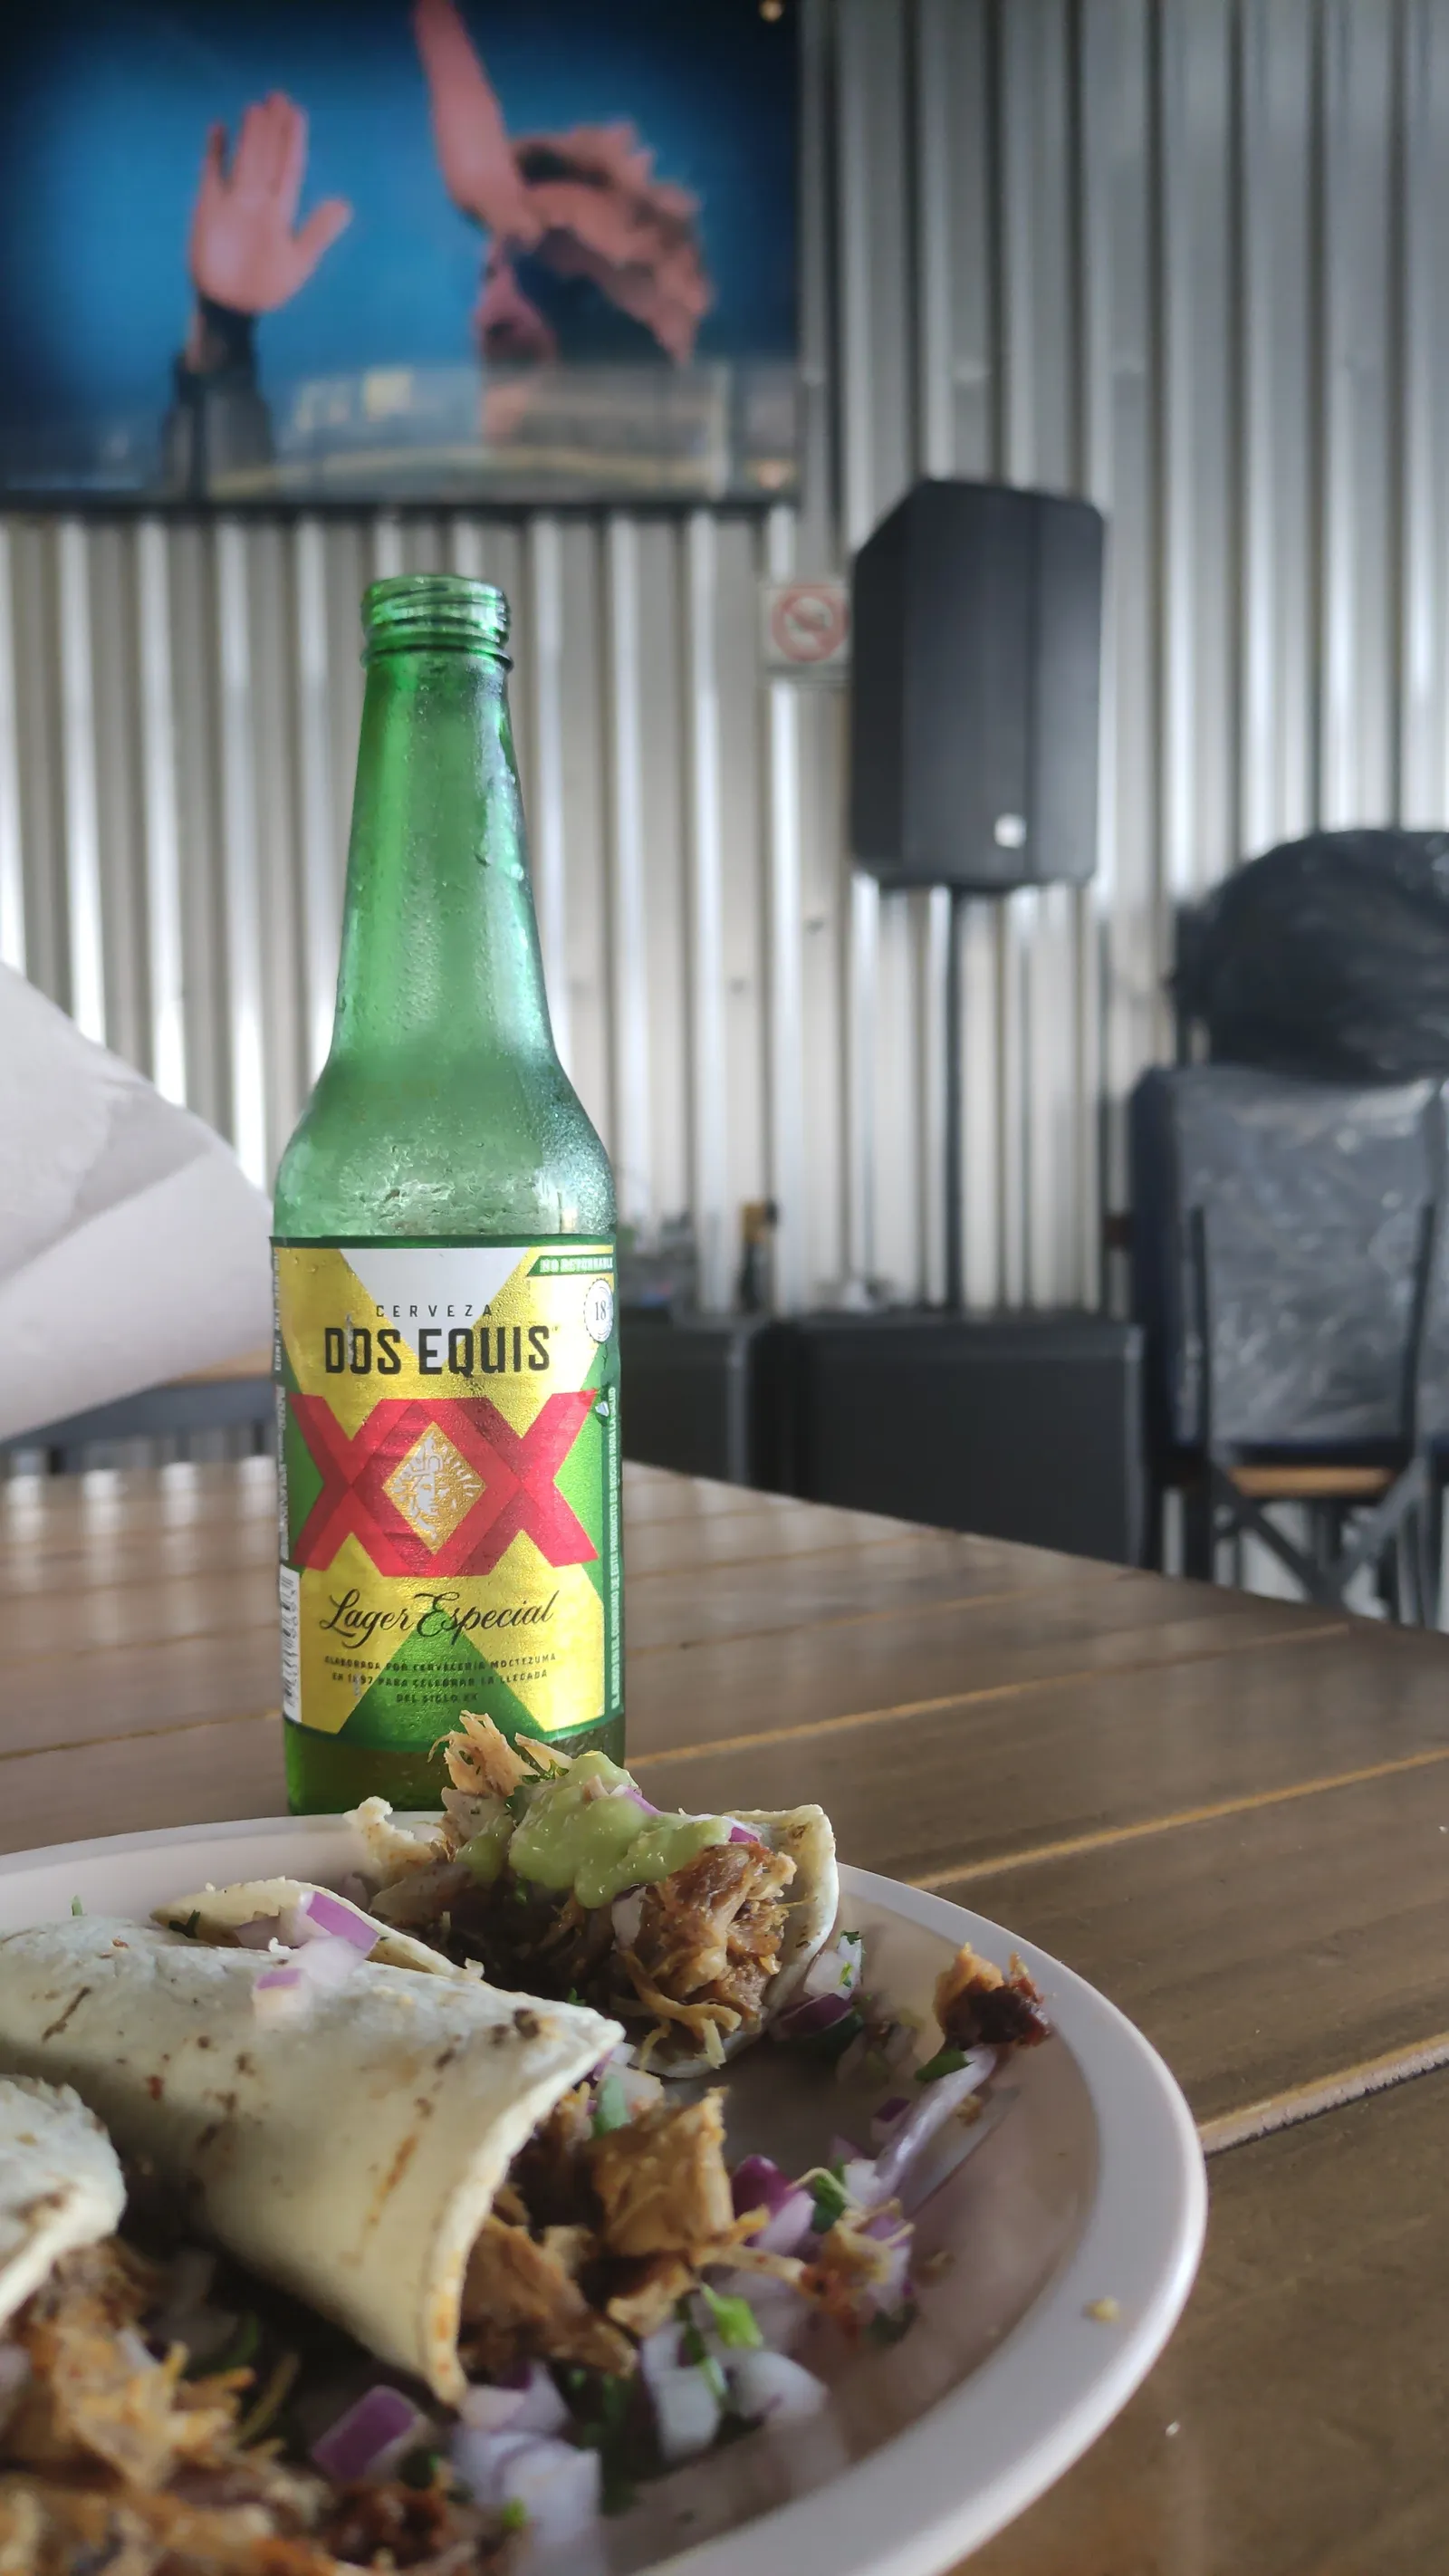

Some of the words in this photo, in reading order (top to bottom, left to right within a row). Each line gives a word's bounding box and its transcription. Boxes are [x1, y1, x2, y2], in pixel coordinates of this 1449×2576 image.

[376, 1304, 493, 1317] CERVEZA
[595, 1300, 607, 1321] 18
[325, 1327, 401, 1375] DOS
[418, 1325, 550, 1378] EQUIS
[609, 1418, 616, 1430] LA
[609, 1432, 617, 1454] PARA
[609, 1490, 618, 1502] ES
[320, 1589, 414, 1648] Lager
[415, 1590, 560, 1645] Especial
[324, 1655, 380, 1669] ELABORADA
[490, 1653, 556, 1669] MOCTEZUMA
